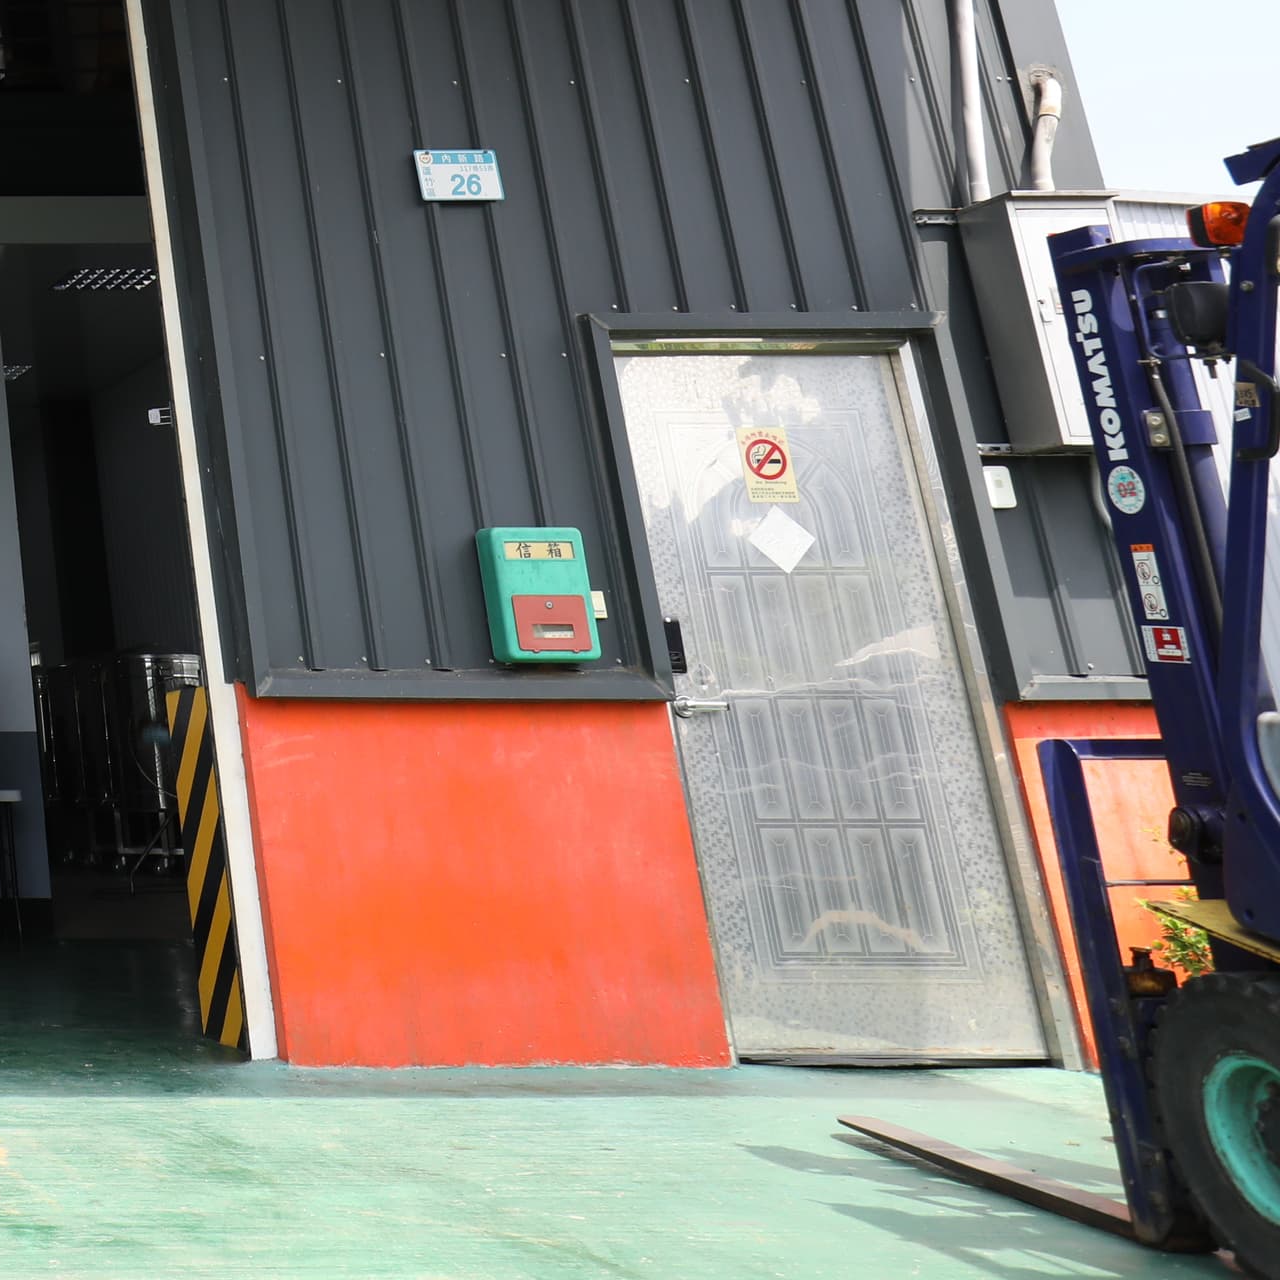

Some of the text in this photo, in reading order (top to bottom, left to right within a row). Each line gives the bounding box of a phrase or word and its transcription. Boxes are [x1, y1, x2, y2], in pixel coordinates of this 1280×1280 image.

[450, 174, 482, 196] 26
[1071, 287, 1129, 462] KOMATSU
[515, 542, 563, 559] 信箱
